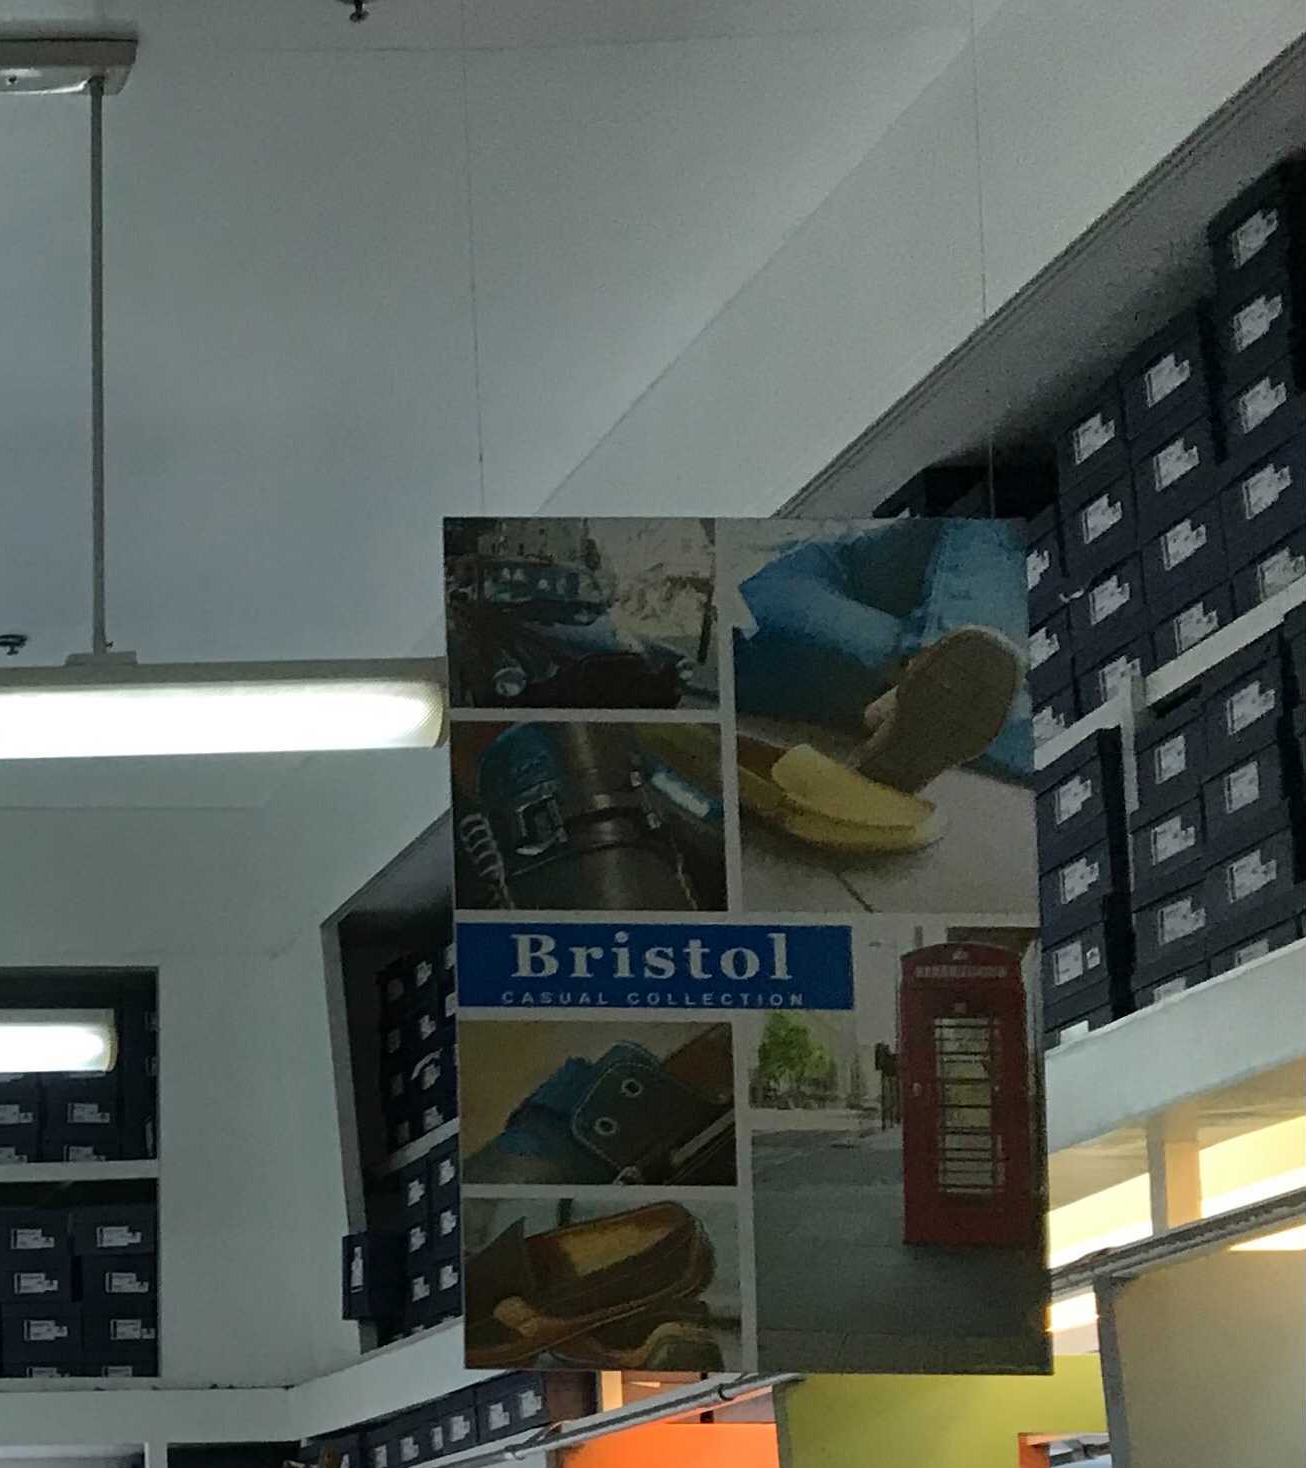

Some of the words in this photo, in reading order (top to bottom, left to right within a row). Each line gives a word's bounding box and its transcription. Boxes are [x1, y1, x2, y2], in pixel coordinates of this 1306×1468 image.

[510, 930, 793, 981] Bristol
[501, 991, 609, 1006] CASUAL
[626, 990, 805, 1007] COLLECTION
